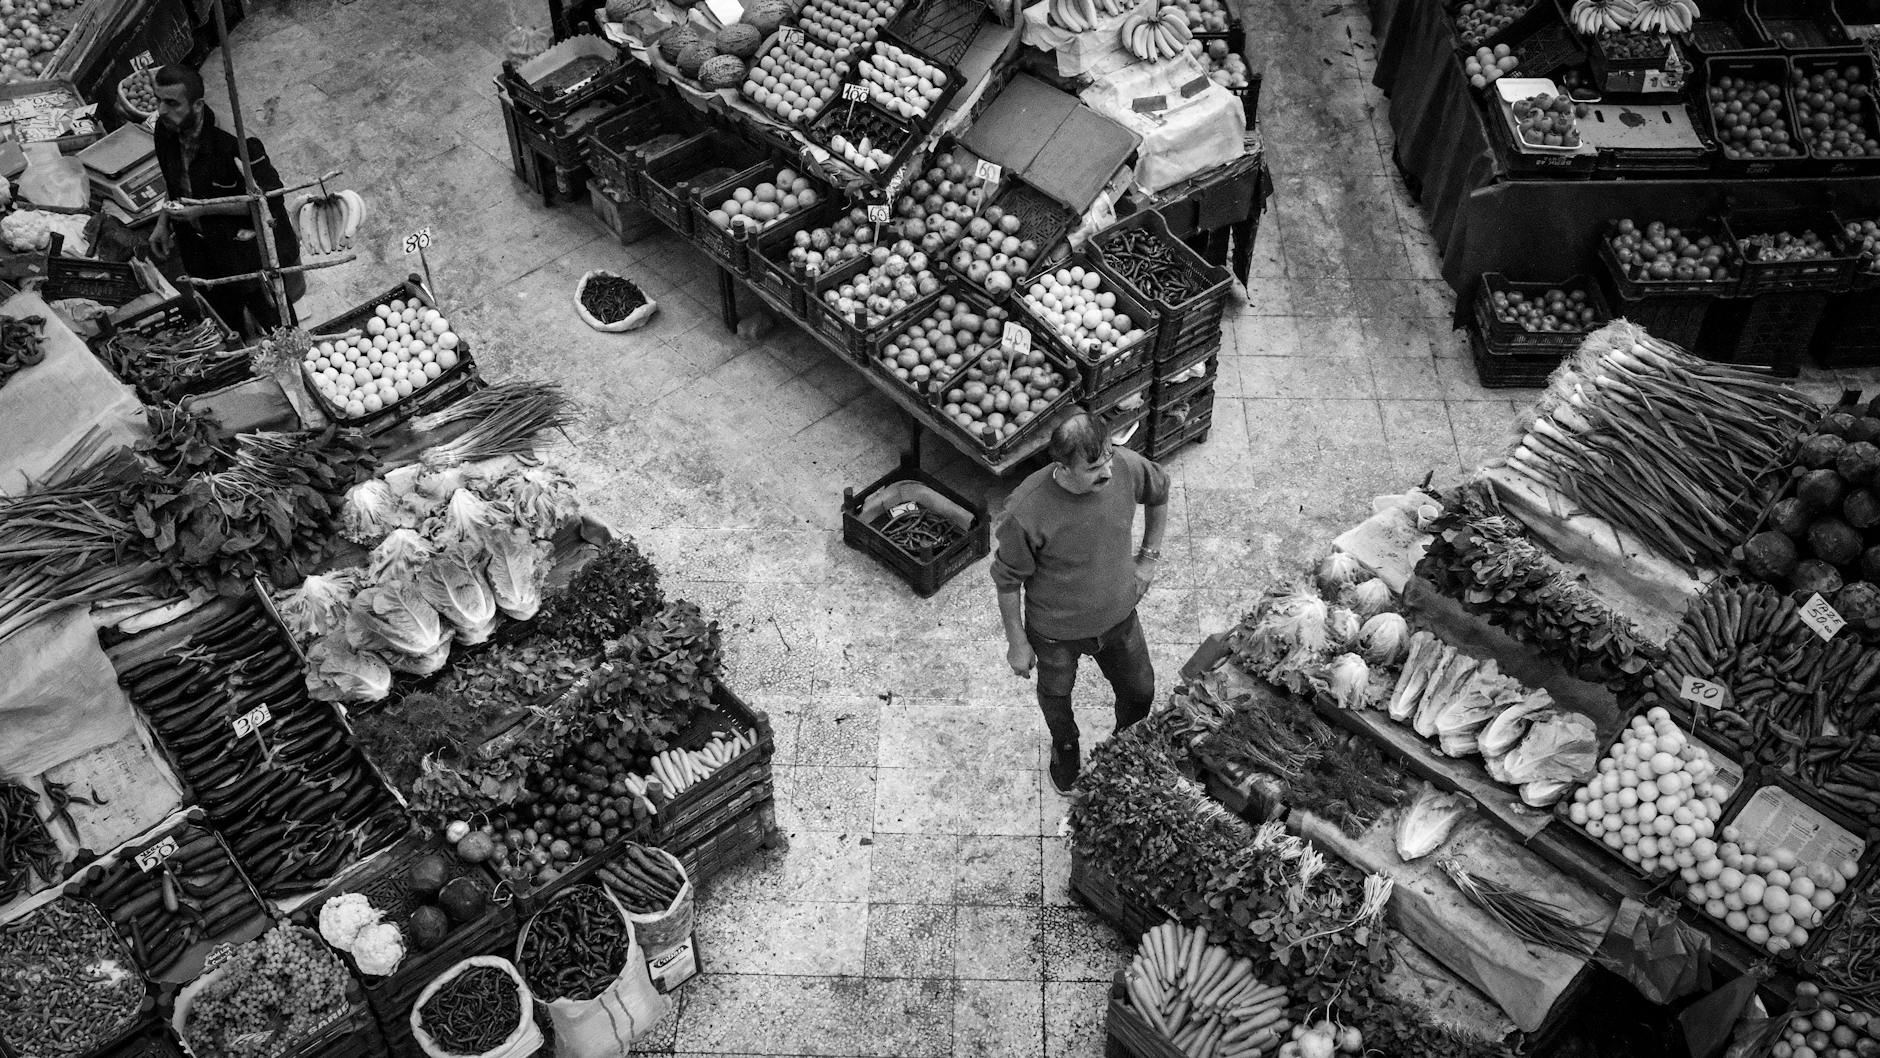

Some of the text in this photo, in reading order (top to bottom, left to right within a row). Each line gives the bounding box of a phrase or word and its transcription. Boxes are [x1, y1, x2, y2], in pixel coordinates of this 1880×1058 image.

[844, 86, 868, 102] 100
[979, 162, 995, 179] 60
[870, 206, 887, 221] 60
[406, 233, 430, 253] 80
[1005, 327, 1023, 345] 40
[1816, 598, 1841, 624] TAZE
[1691, 682, 1718, 698] 80
[238, 710, 265, 737] 30
[141, 844, 175, 870] 50
